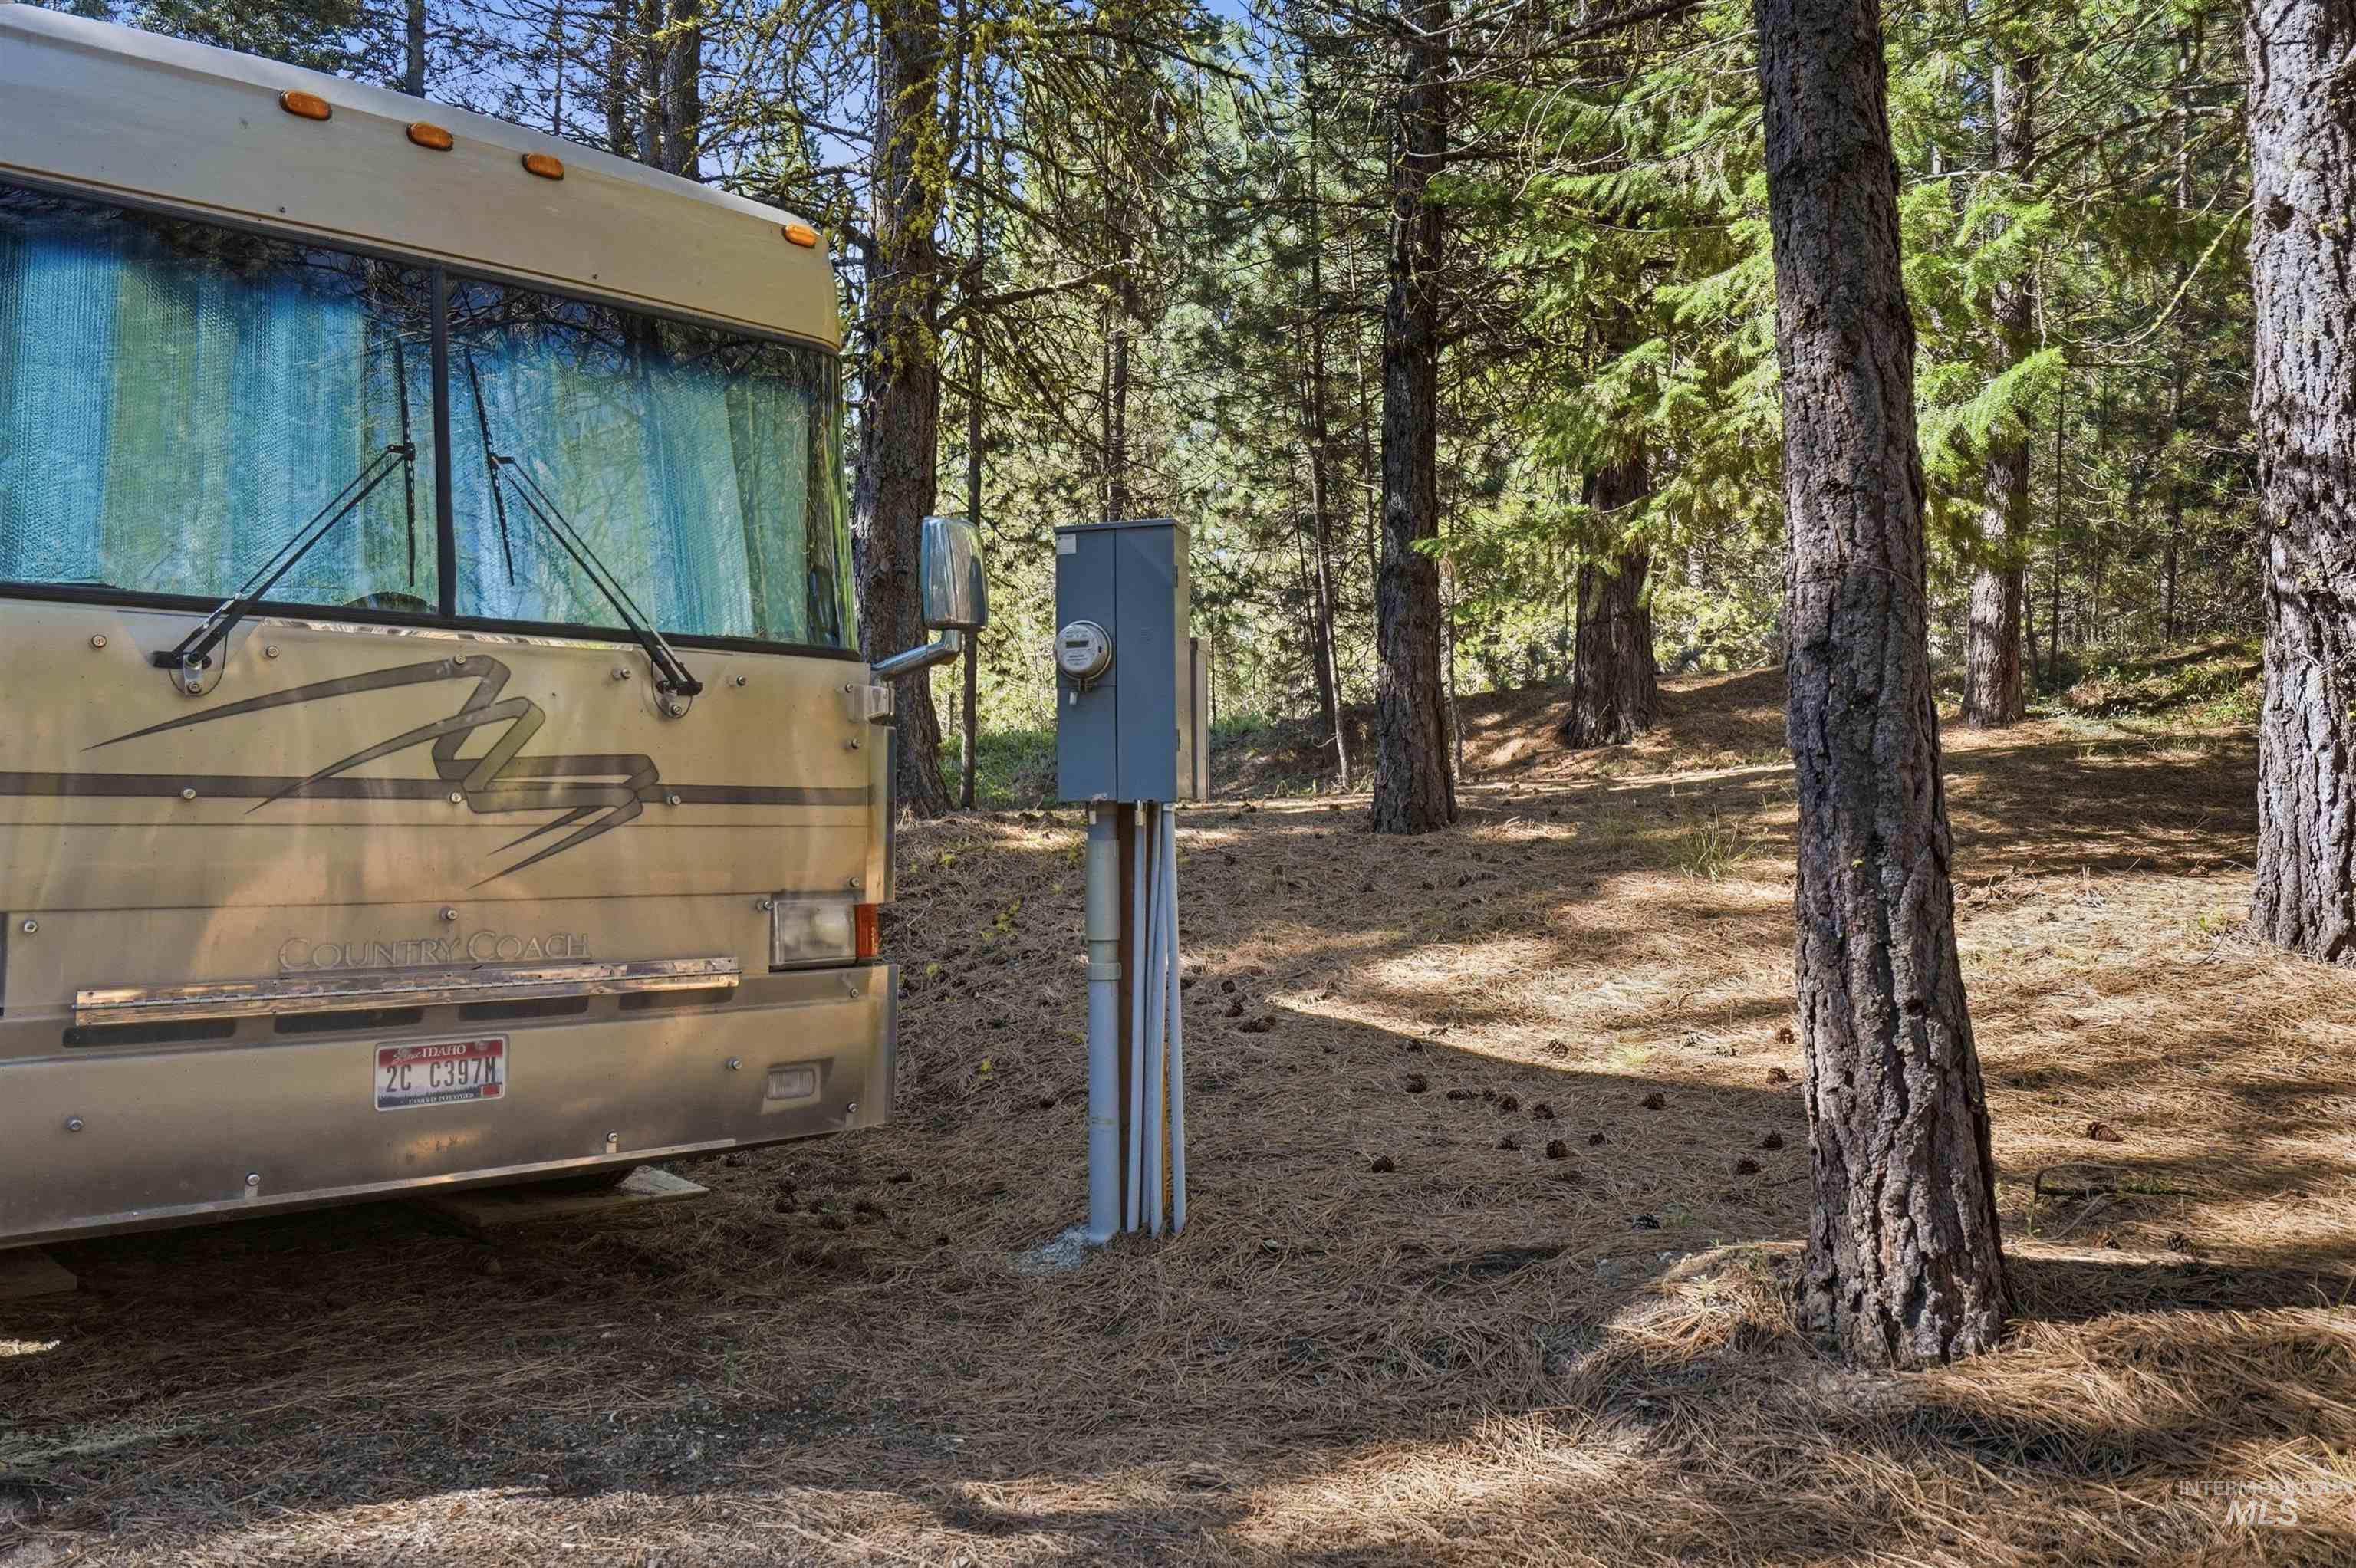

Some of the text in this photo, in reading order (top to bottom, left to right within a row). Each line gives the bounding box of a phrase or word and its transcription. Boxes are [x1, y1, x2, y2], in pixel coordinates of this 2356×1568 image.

[278, 931, 591, 971] COUNTRY COACH
[422, 1045, 466, 1057] IDAHO
[387, 1065, 411, 1092] 2C
